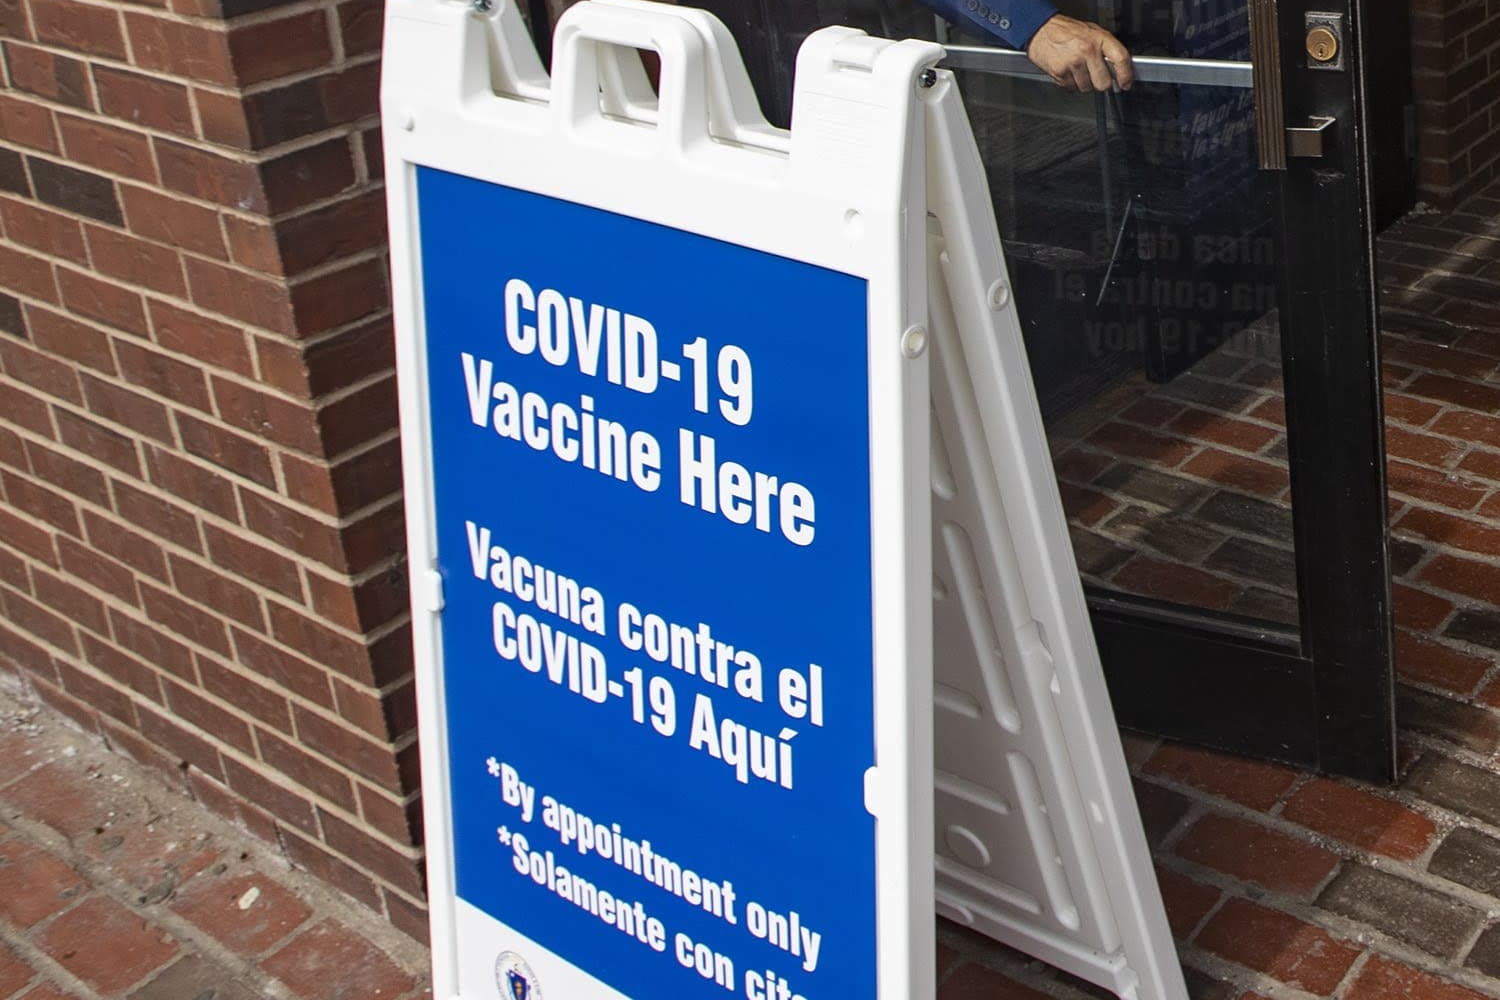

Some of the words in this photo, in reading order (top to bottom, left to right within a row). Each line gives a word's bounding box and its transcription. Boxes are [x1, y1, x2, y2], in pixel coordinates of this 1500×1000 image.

[503, 277, 754, 427] COVID-19
[460, 351, 662, 493] Vaccine
[678, 427, 817, 547] Here
[464, 519, 607, 637] Vacuna
[617, 601, 764, 704] contra
[777, 662, 824, 728] el
[491, 600, 677, 738] COVID-19
[688, 692, 799, 791] Aquí
[540, 794, 738, 926] appointment
[745, 900, 822, 974] only
[673, 931, 736, 992] con
[744, 968, 809, 1000] cit
